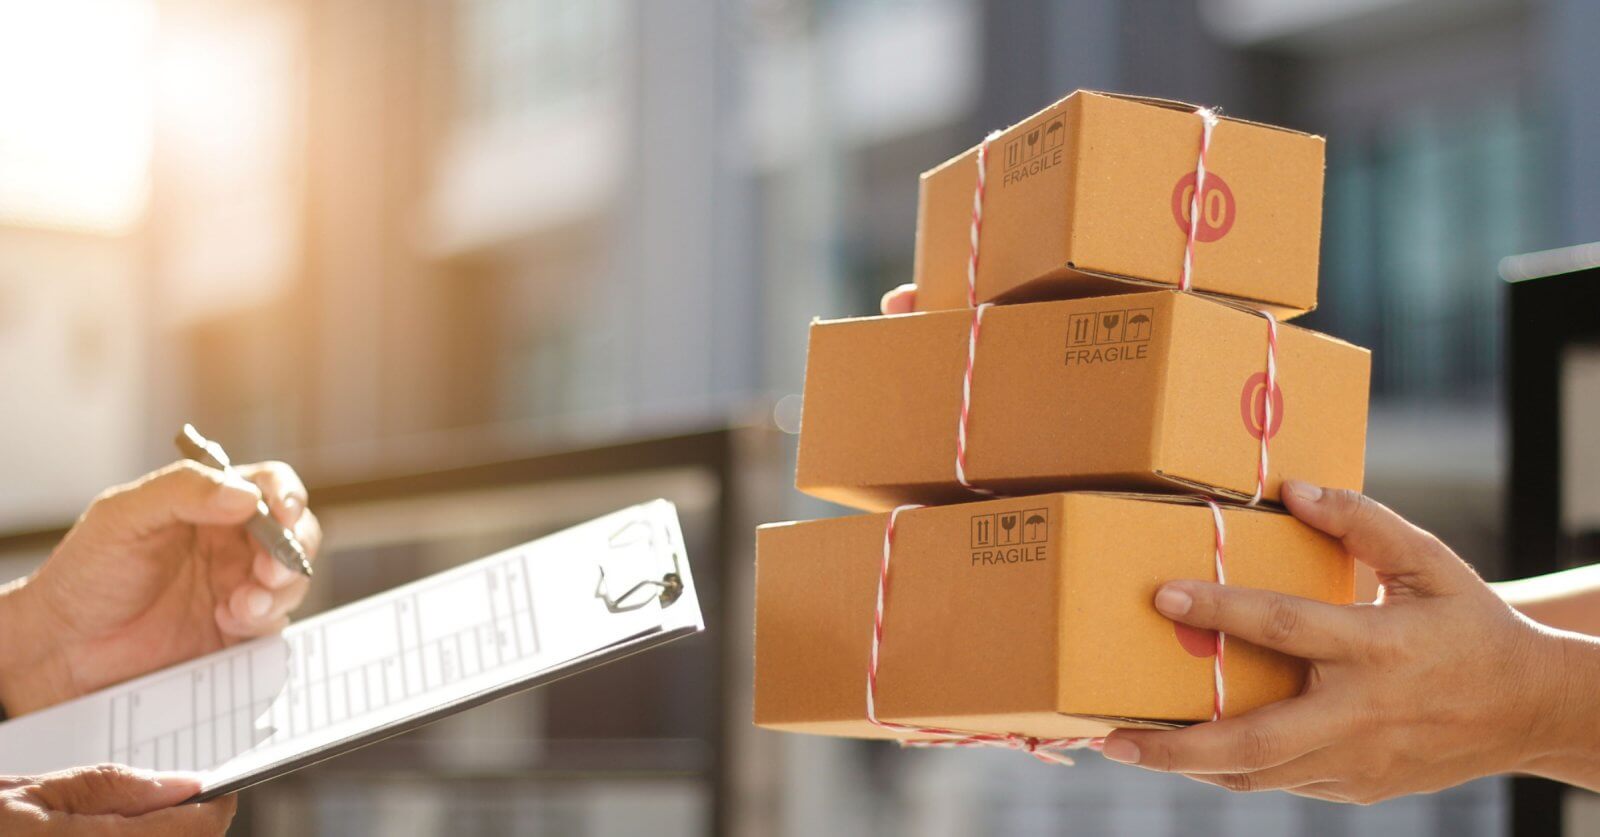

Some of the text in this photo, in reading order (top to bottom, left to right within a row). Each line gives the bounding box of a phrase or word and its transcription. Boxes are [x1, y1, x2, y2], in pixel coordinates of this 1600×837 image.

[1003, 149, 1064, 189] FRAGILE
[1065, 344, 1148, 366] FRAGILE
[971, 546, 1047, 566] FRAGILE
